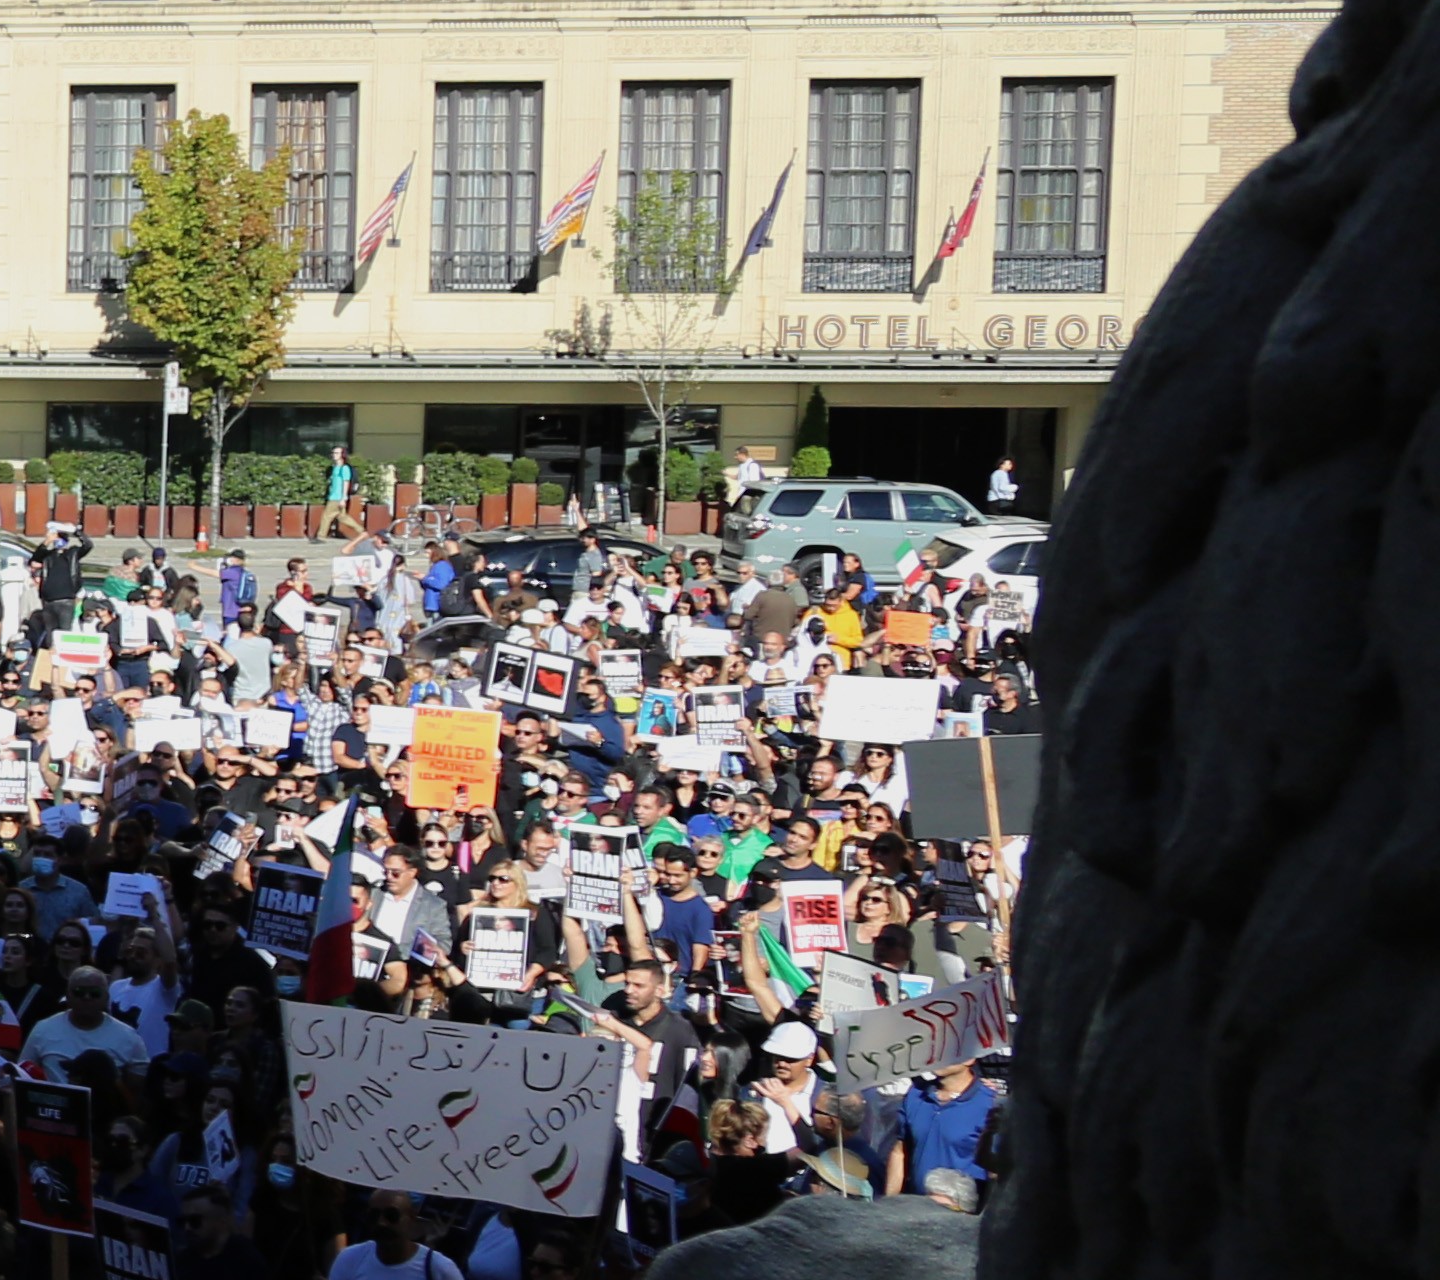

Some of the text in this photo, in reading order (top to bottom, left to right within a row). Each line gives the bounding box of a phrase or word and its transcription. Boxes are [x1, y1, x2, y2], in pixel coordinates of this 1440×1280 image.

[782, 314, 939, 350] HOTEL
[422, 741, 486, 761] UNITED
[571, 849, 621, 877] IRAN
[257, 886, 316, 915] IRAN
[793, 899, 838, 919] RISE
[903, 969, 1007, 1066] IRAN
[38, 1107, 61, 1120] LIFE
